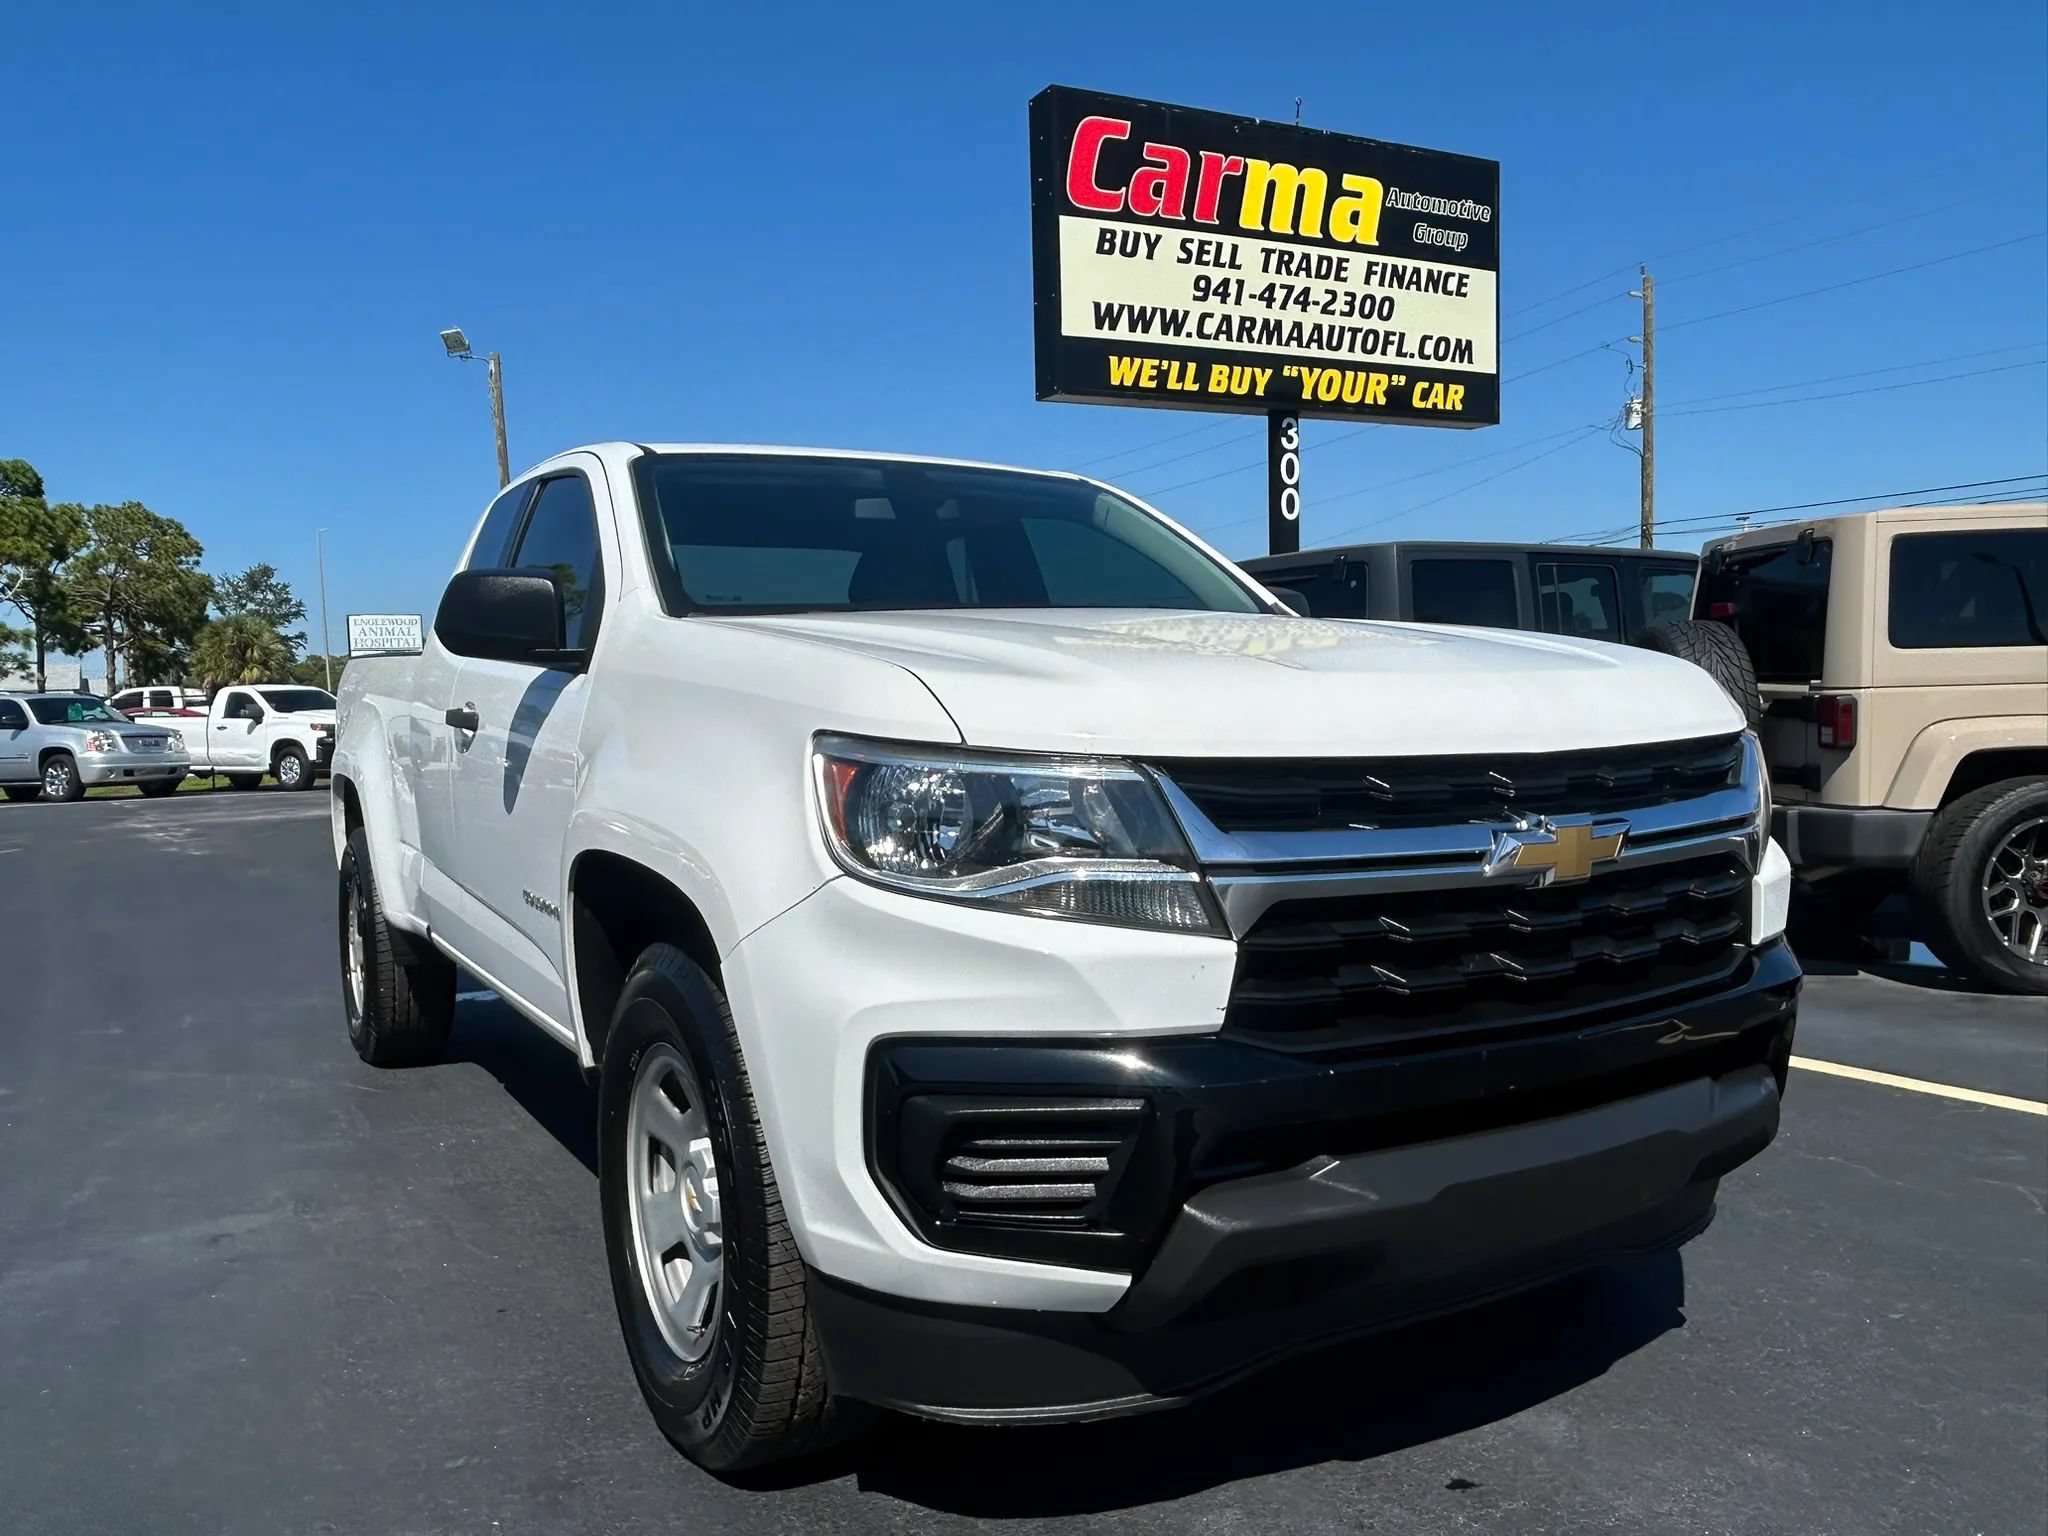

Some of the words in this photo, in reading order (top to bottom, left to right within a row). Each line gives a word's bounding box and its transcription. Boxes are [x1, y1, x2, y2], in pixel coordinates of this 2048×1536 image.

[1066, 115, 1383, 246] Carma
[1386, 187, 1491, 223] Automotive
[1413, 222, 1468, 252] Group
[1096, 227, 1163, 260] BUY
[1176, 237, 1242, 270] SELL
[1260, 247, 1350, 283] TRADE
[1363, 260, 1470, 298] FINANCE
[1192, 274, 1395, 322] 941-474-2300
[1092, 301, 1474, 364] WWW.CARMAAUTOFL.COM
[1109, 355, 1200, 391] WE'LL
[1208, 364, 1273, 396] BUY
[1412, 381, 1465, 411] CAR
[1281, 417, 1300, 520] 300
[353, 618, 418, 626] ENGLEWOOD
[354, 637, 420, 648] HOSPITAL
[359, 626, 416, 637] ANIMAL
